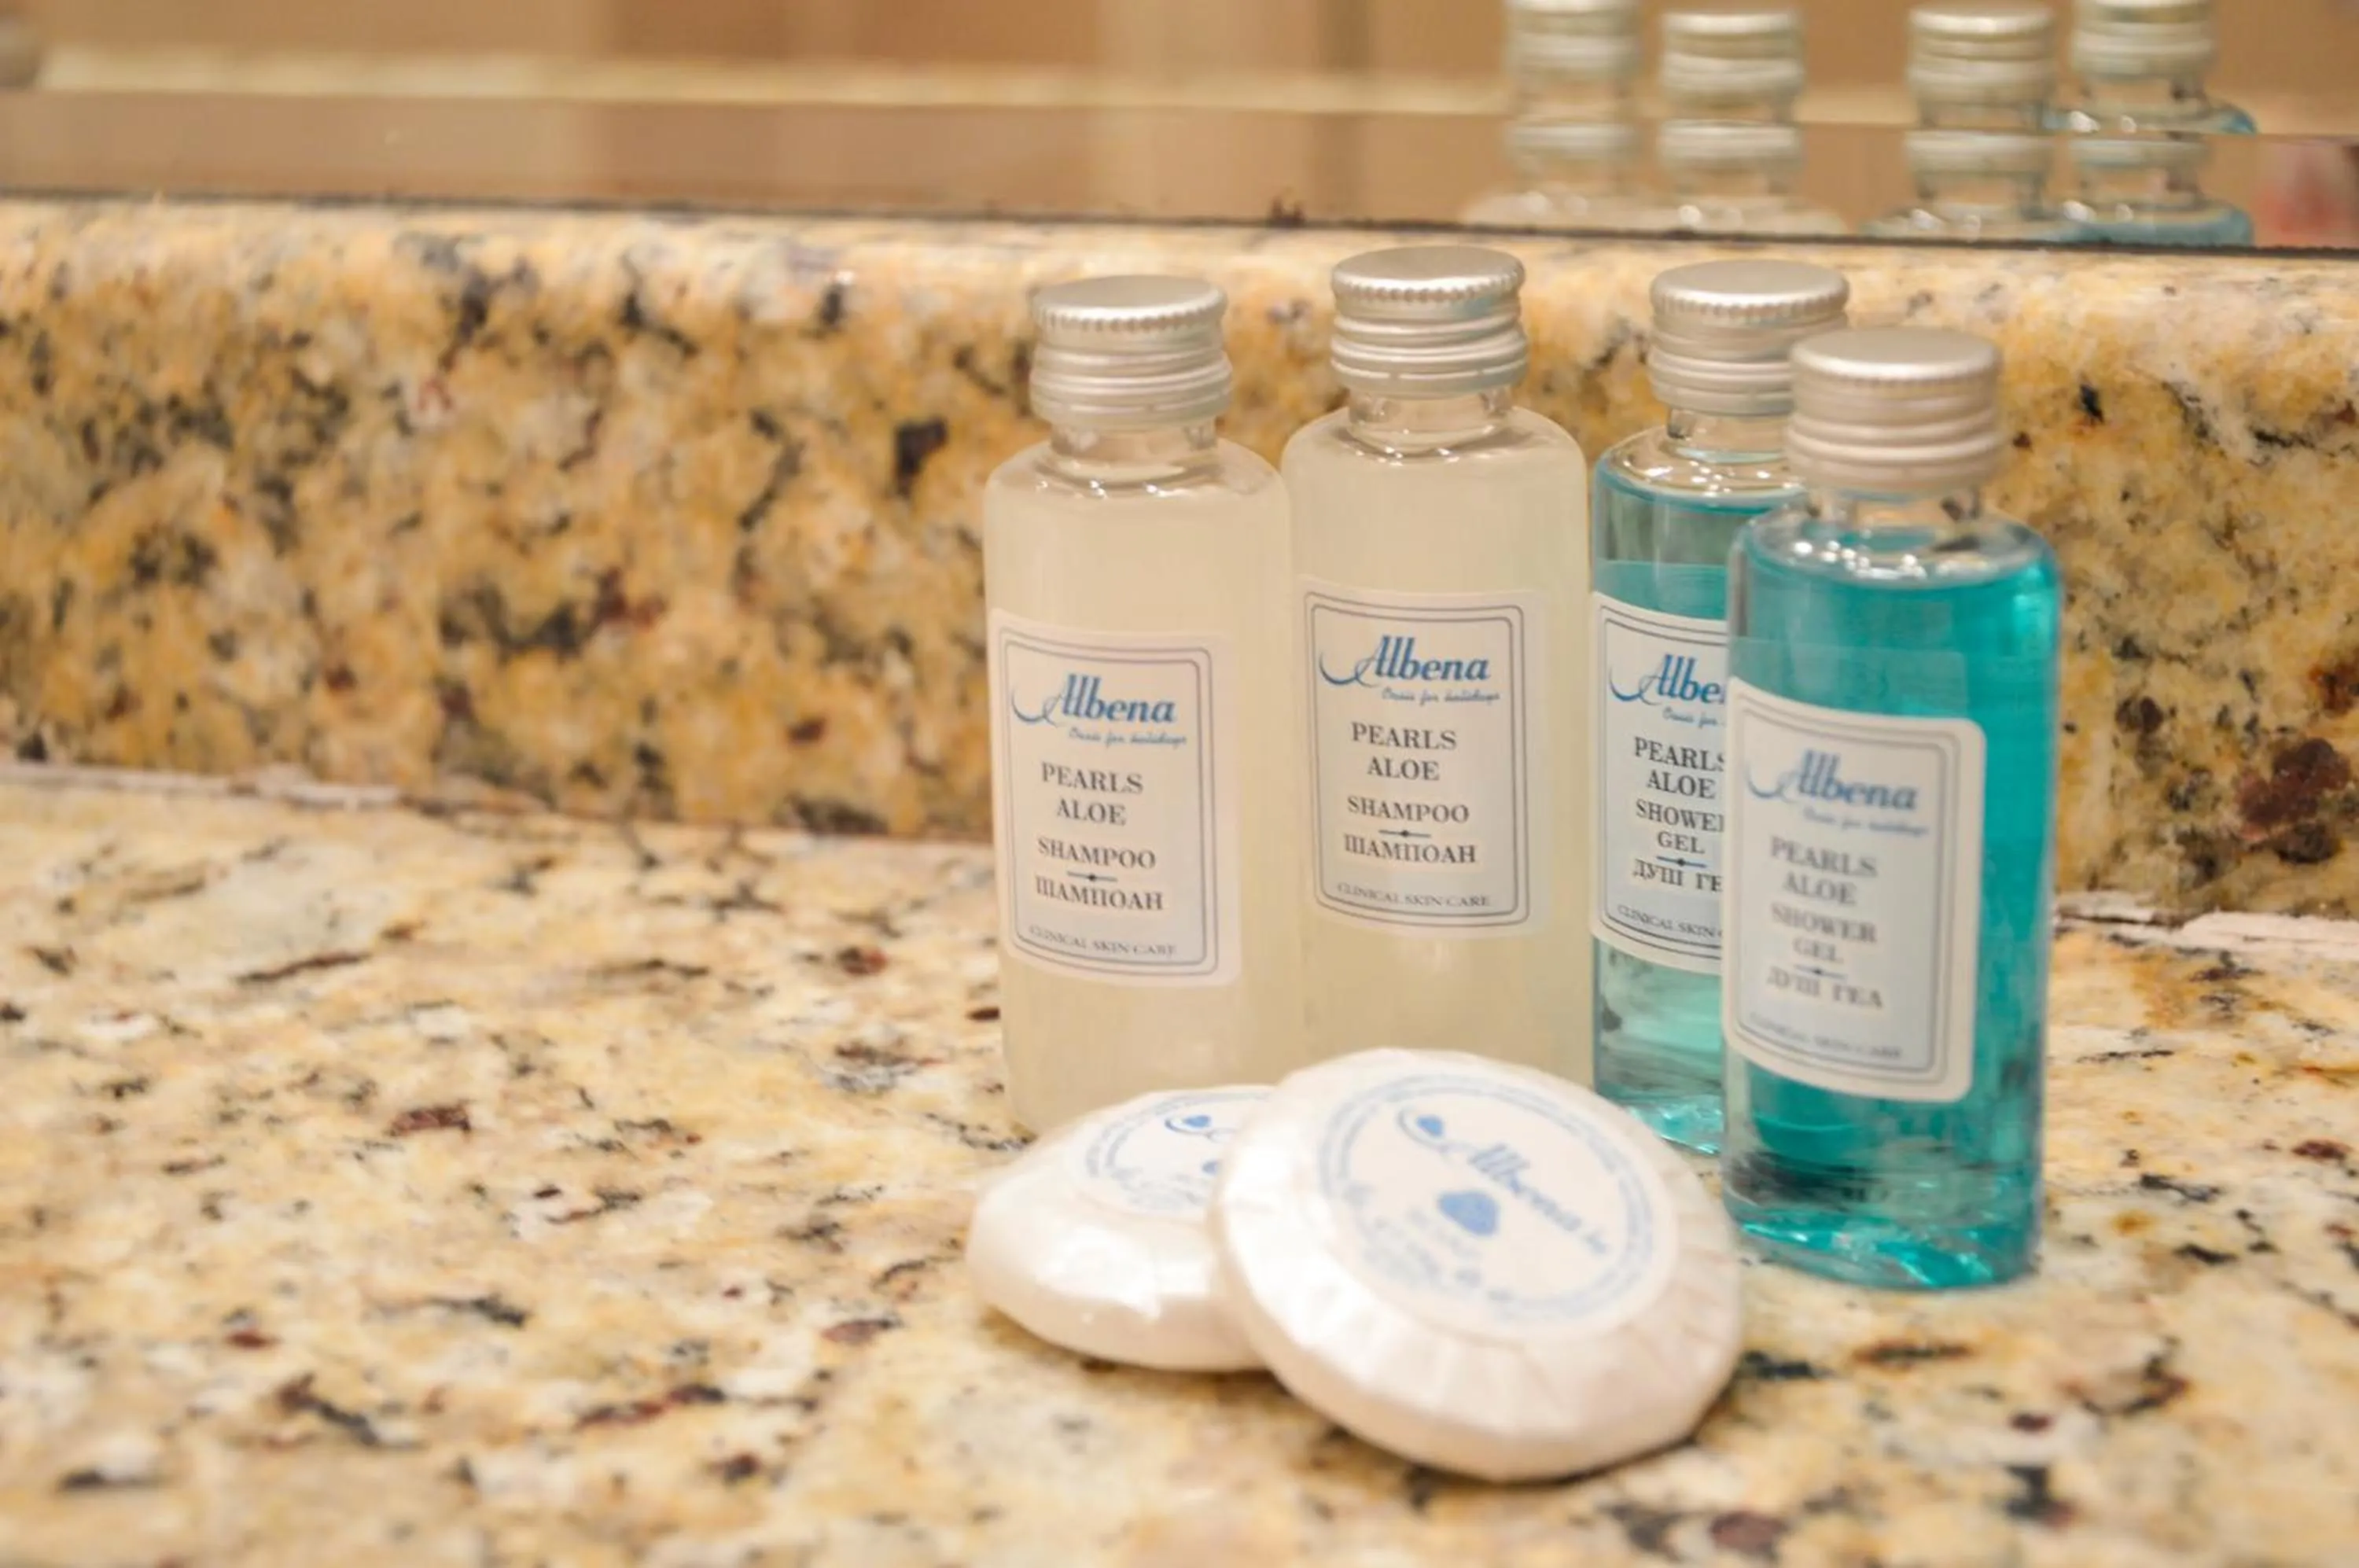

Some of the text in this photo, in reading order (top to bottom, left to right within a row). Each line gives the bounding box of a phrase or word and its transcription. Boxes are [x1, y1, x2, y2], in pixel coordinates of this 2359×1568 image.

[1319, 635, 1491, 687] Albena
[1609, 653, 1724, 705] Albe
[1011, 672, 1176, 728] Albena
[1352, 721, 1456, 750] PEARLS
[1041, 761, 1143, 795] PEARLS
[1367, 756, 1440, 781] ALOE
[1647, 771, 1715, 800] ALOE
[1746, 749, 1917, 812] Albena
[1056, 798, 1127, 826] ALOE
[1347, 795, 1470, 823] SHAMPOO
[1636, 799, 1724, 833] SHOWE
[1037, 837, 1156, 870] SHAMPOO
[1343, 834, 1477, 864] ШАМПОАН
[1657, 830, 1705, 855] GEL
[1769, 834, 1878, 879] PEARLS
[1034, 874, 1164, 911] ШАМПОАН
[1632, 858, 1723, 893] ДУШ ГЕ
[1782, 870, 1857, 907] ALOE
[1404, 893, 1442, 907] SKIN
[1769, 901, 1877, 944] SHOWER
[1793, 938, 1844, 964] GEL
